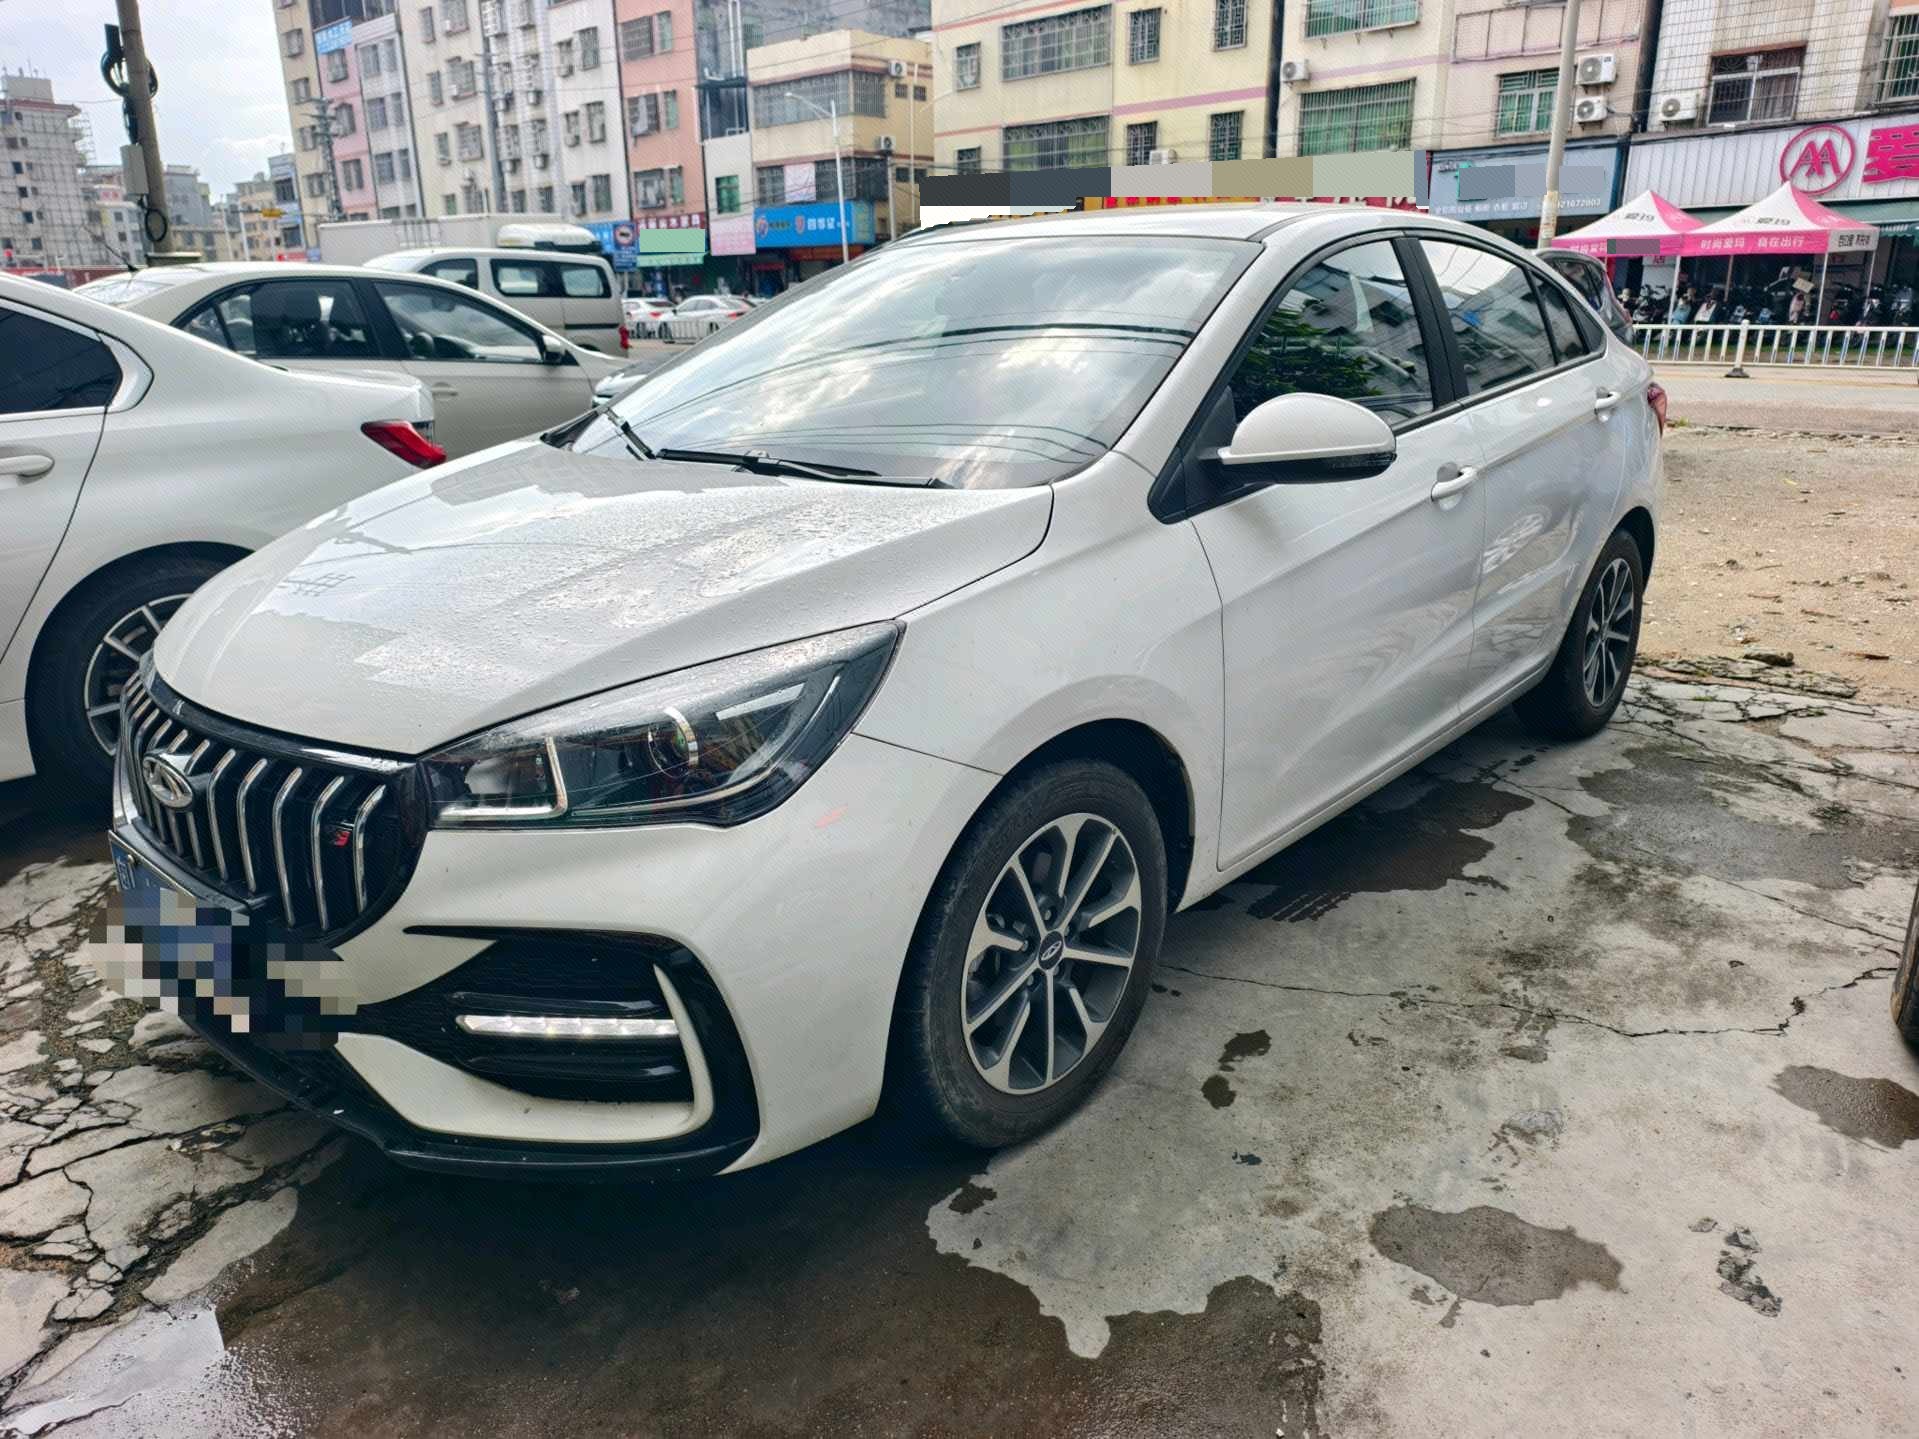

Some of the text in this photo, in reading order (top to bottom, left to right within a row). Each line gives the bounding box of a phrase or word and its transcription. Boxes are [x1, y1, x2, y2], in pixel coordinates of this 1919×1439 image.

[1701, 236, 1805, 249] 时尚爱玛 自在出行
